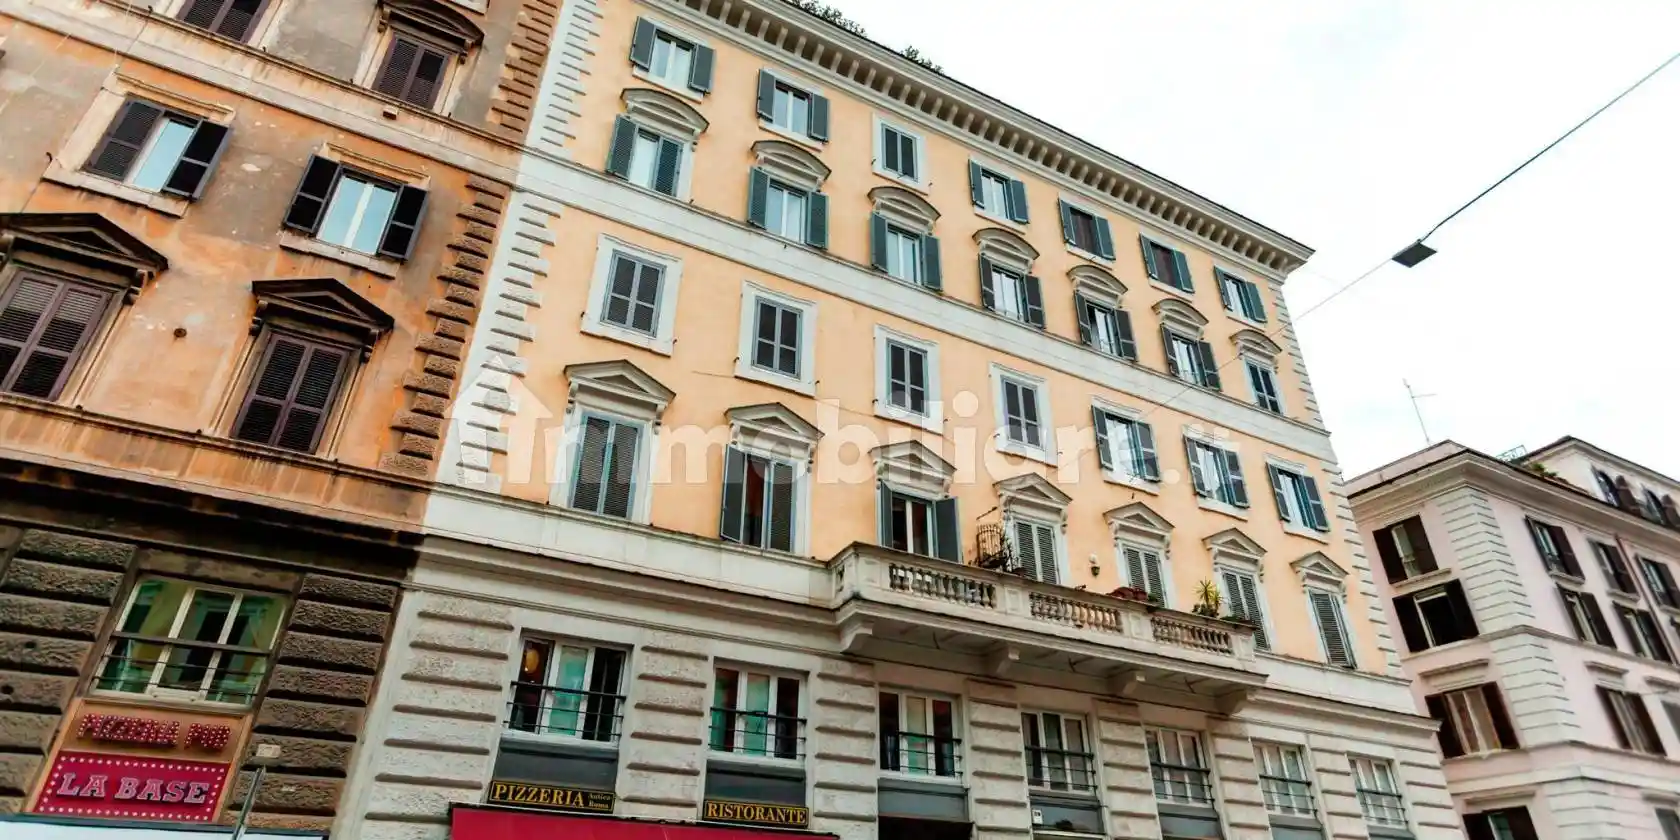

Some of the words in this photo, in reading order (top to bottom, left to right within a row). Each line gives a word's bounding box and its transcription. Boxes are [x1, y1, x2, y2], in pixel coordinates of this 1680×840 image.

[57, 772, 108, 798] LA
[114, 776, 209, 804] BASE
[494, 784, 584, 808] PIZZERIA
[708, 802, 806, 825] RISTORANTE
